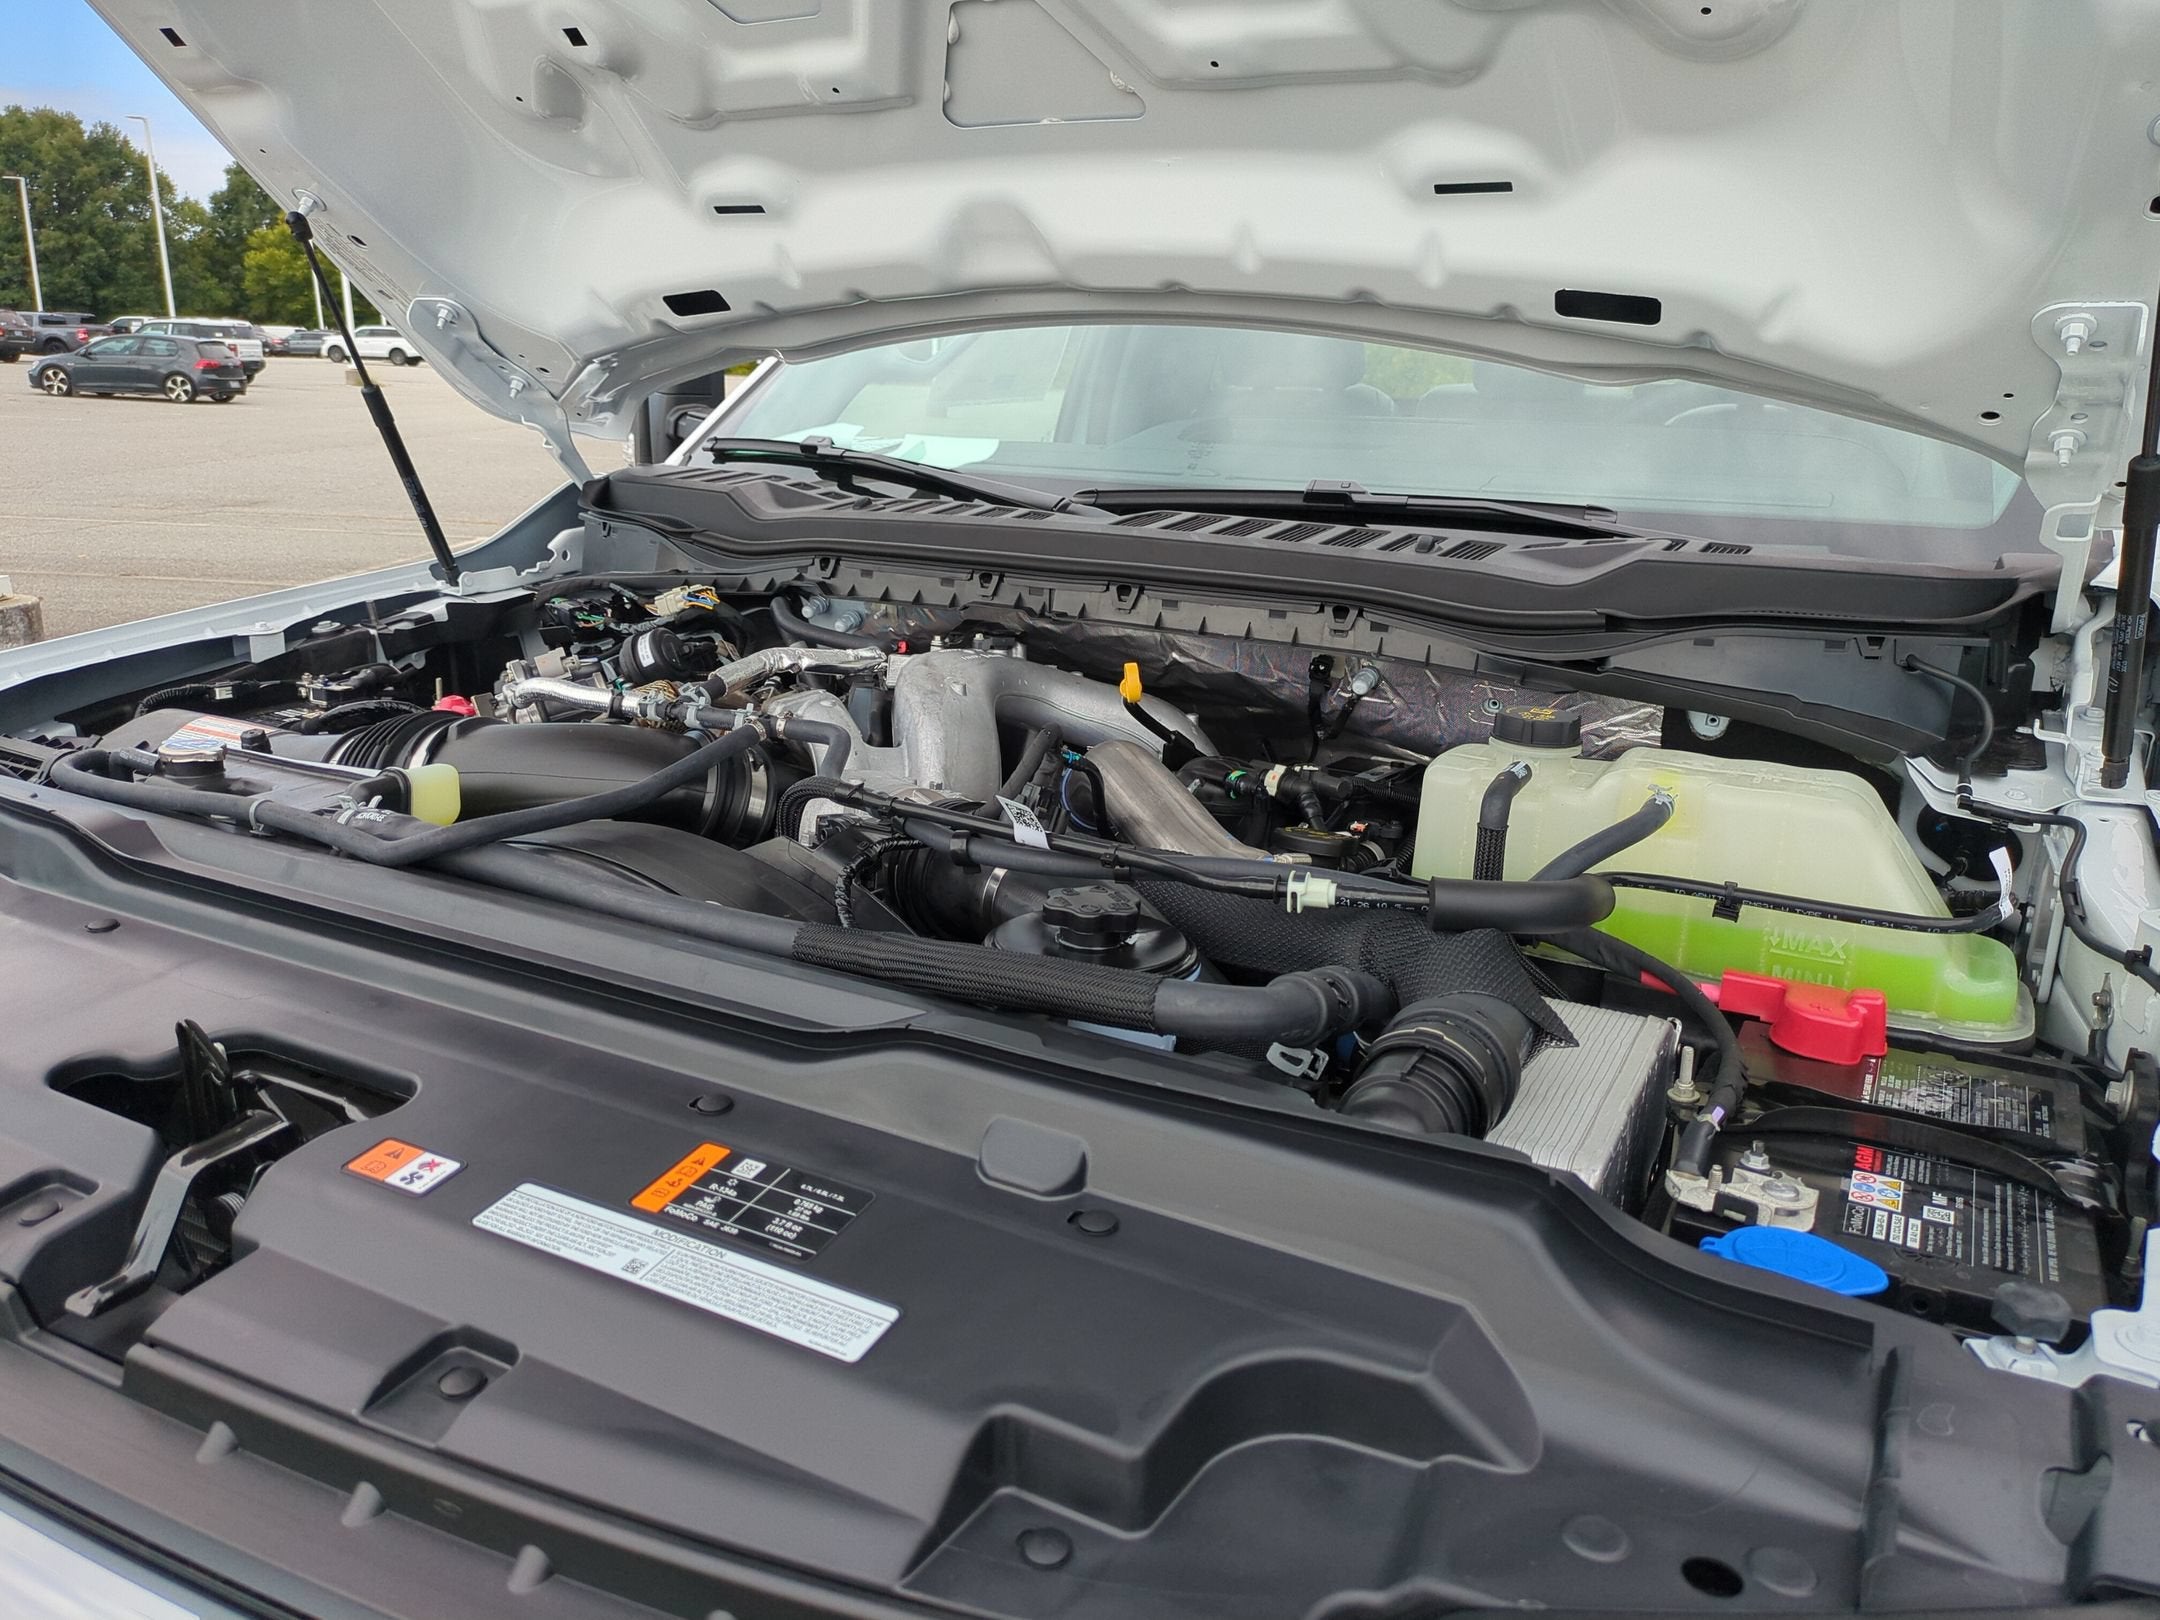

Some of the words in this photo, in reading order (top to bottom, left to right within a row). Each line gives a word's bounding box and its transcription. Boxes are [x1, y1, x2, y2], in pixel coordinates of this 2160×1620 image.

[1782, 927, 1848, 960] MAX
[1854, 1146, 1874, 1172] AGM
[708, 1183, 737, 1197] R-134a
[664, 1205, 698, 1222] FoMoCo
[695, 1200, 715, 1211] PAG
[1848, 1205, 1865, 1234] FoMoCo
[651, 1228, 727, 1259] MODIFICATION
